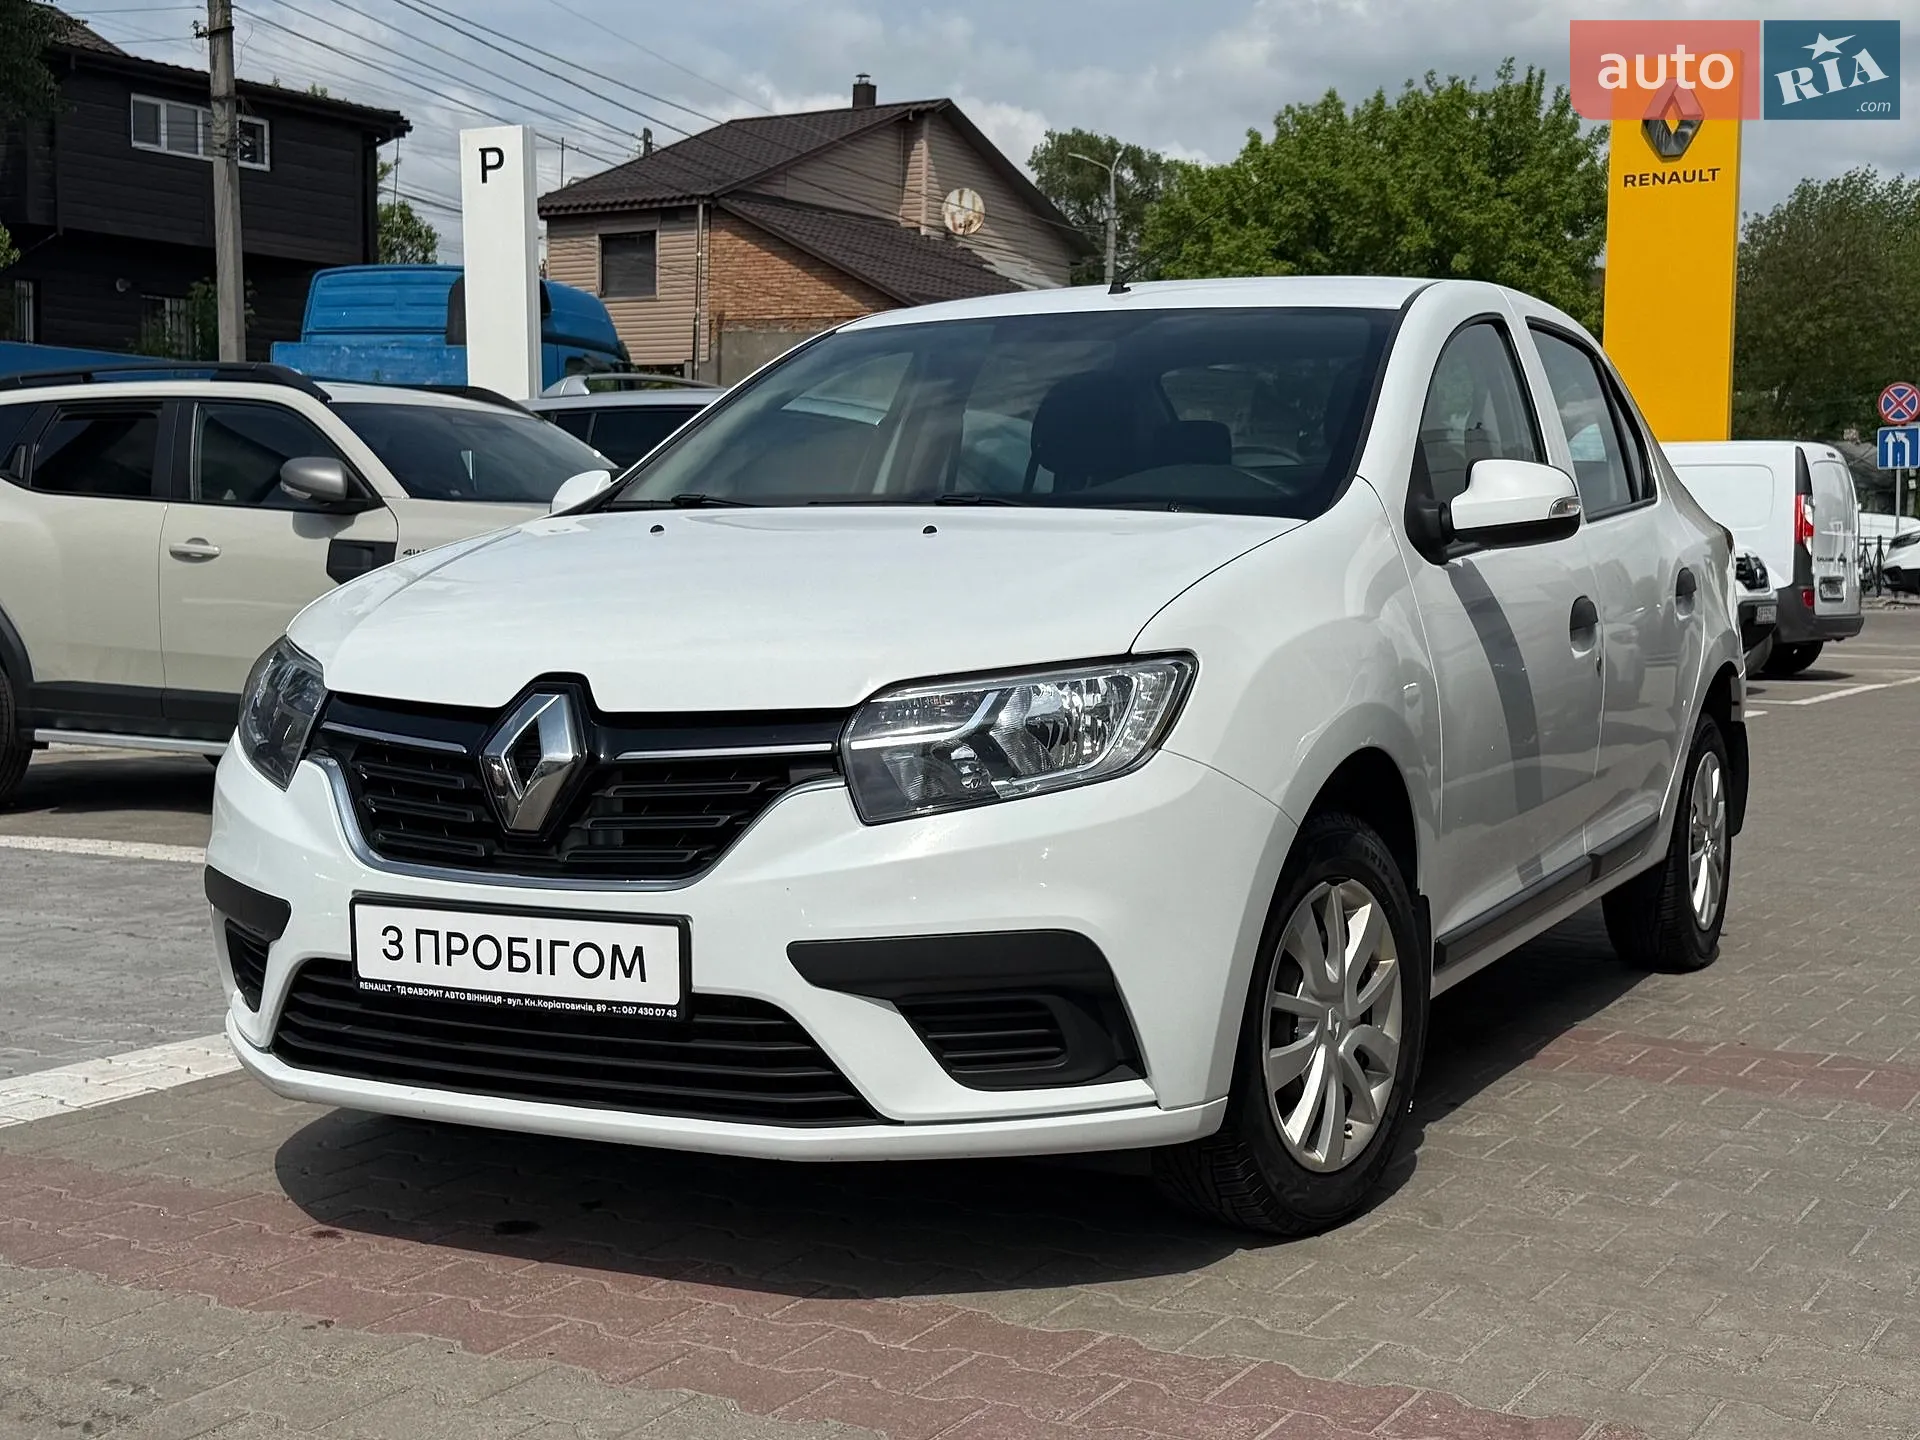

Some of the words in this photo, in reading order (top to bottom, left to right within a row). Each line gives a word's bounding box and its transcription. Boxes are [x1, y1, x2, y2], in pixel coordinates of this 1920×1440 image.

[478, 146, 505, 185] P
[1622, 167, 1721, 188] RENAULT
[414, 927, 647, 983] ПРОБІГОМ
[359, 981, 393, 992] RENAULT
[407, 987, 444, 998] ФАВОРИТ
[444, 990, 466, 1001] АВТО
